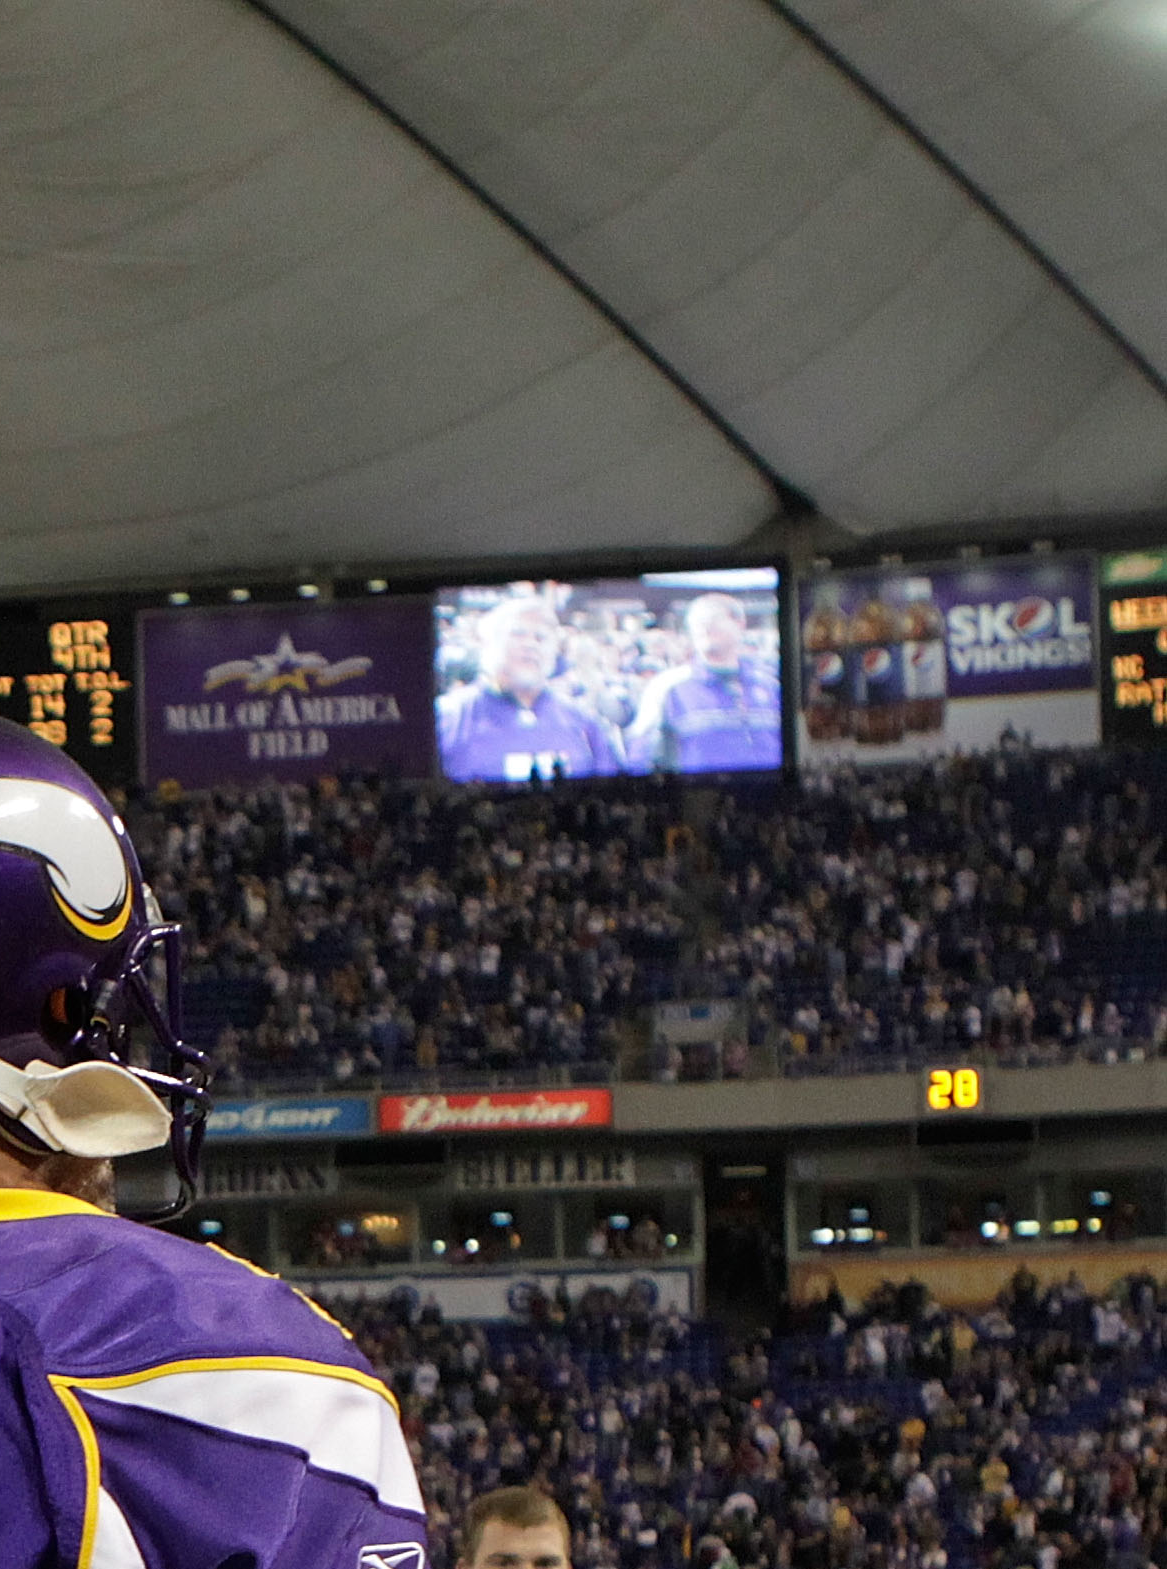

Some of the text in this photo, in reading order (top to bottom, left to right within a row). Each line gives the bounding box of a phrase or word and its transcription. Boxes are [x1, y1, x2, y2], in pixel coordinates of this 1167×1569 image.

[49, 620, 108, 648] QTR
[51, 645, 111, 671] 4TH
[30, 690, 113, 719] 14 2
[164, 692, 401, 730] MALL OF AMERICA
[89, 717, 114, 744] 2
[248, 729, 329, 759] FIELD
[402, 1096, 590, 1132] Budweiser
